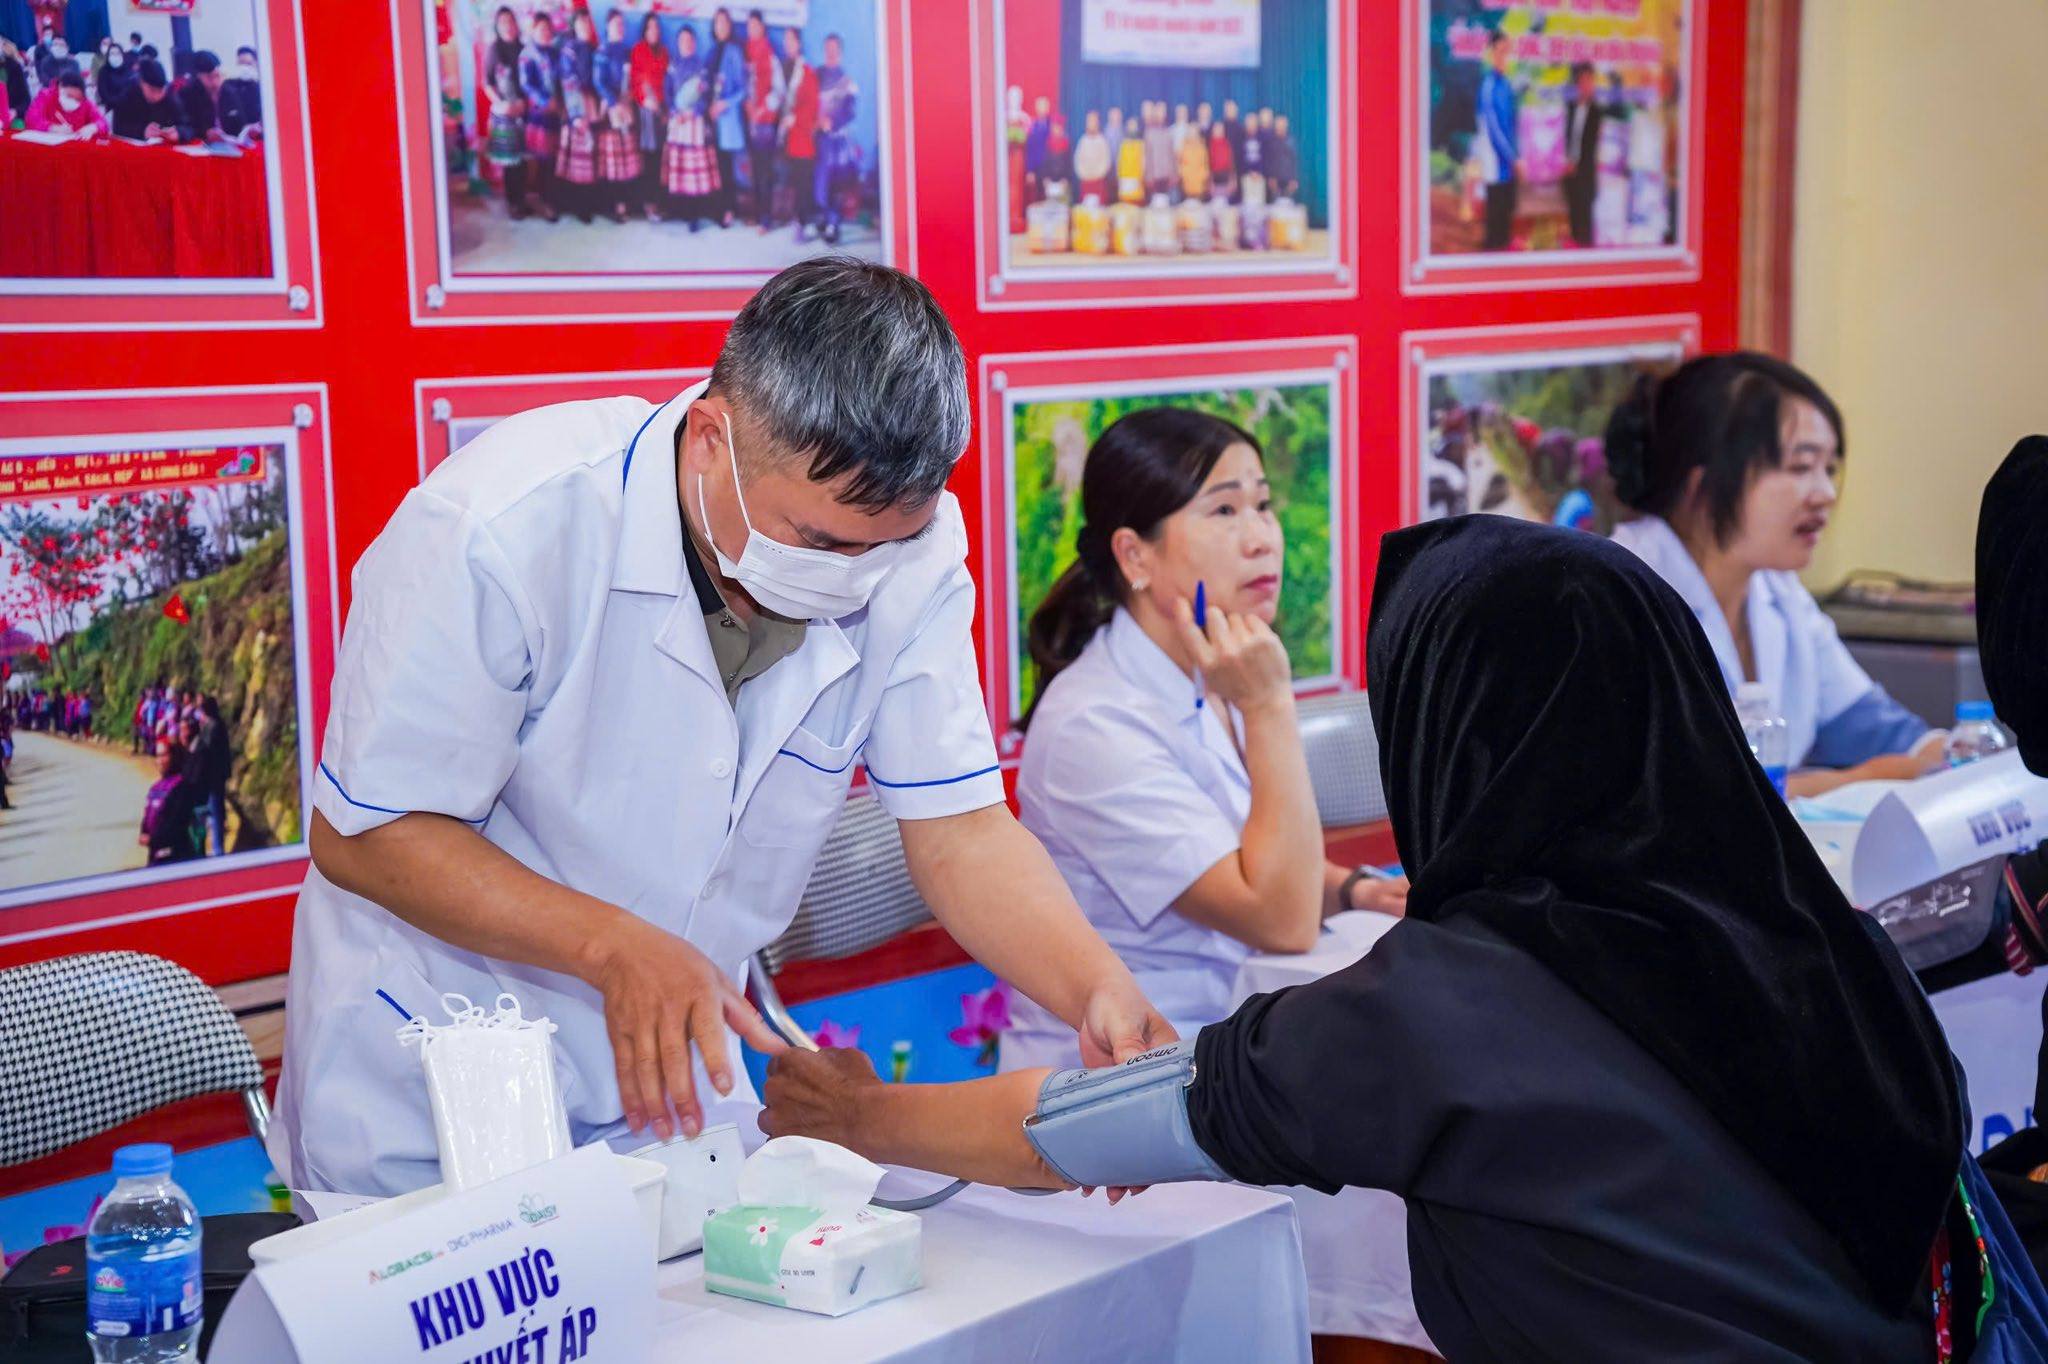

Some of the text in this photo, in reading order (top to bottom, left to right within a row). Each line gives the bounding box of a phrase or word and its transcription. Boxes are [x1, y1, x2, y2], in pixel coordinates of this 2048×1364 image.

[410, 1247, 560, 1350] KHU VỰC
[559, 1306, 597, 1364] ÁP
